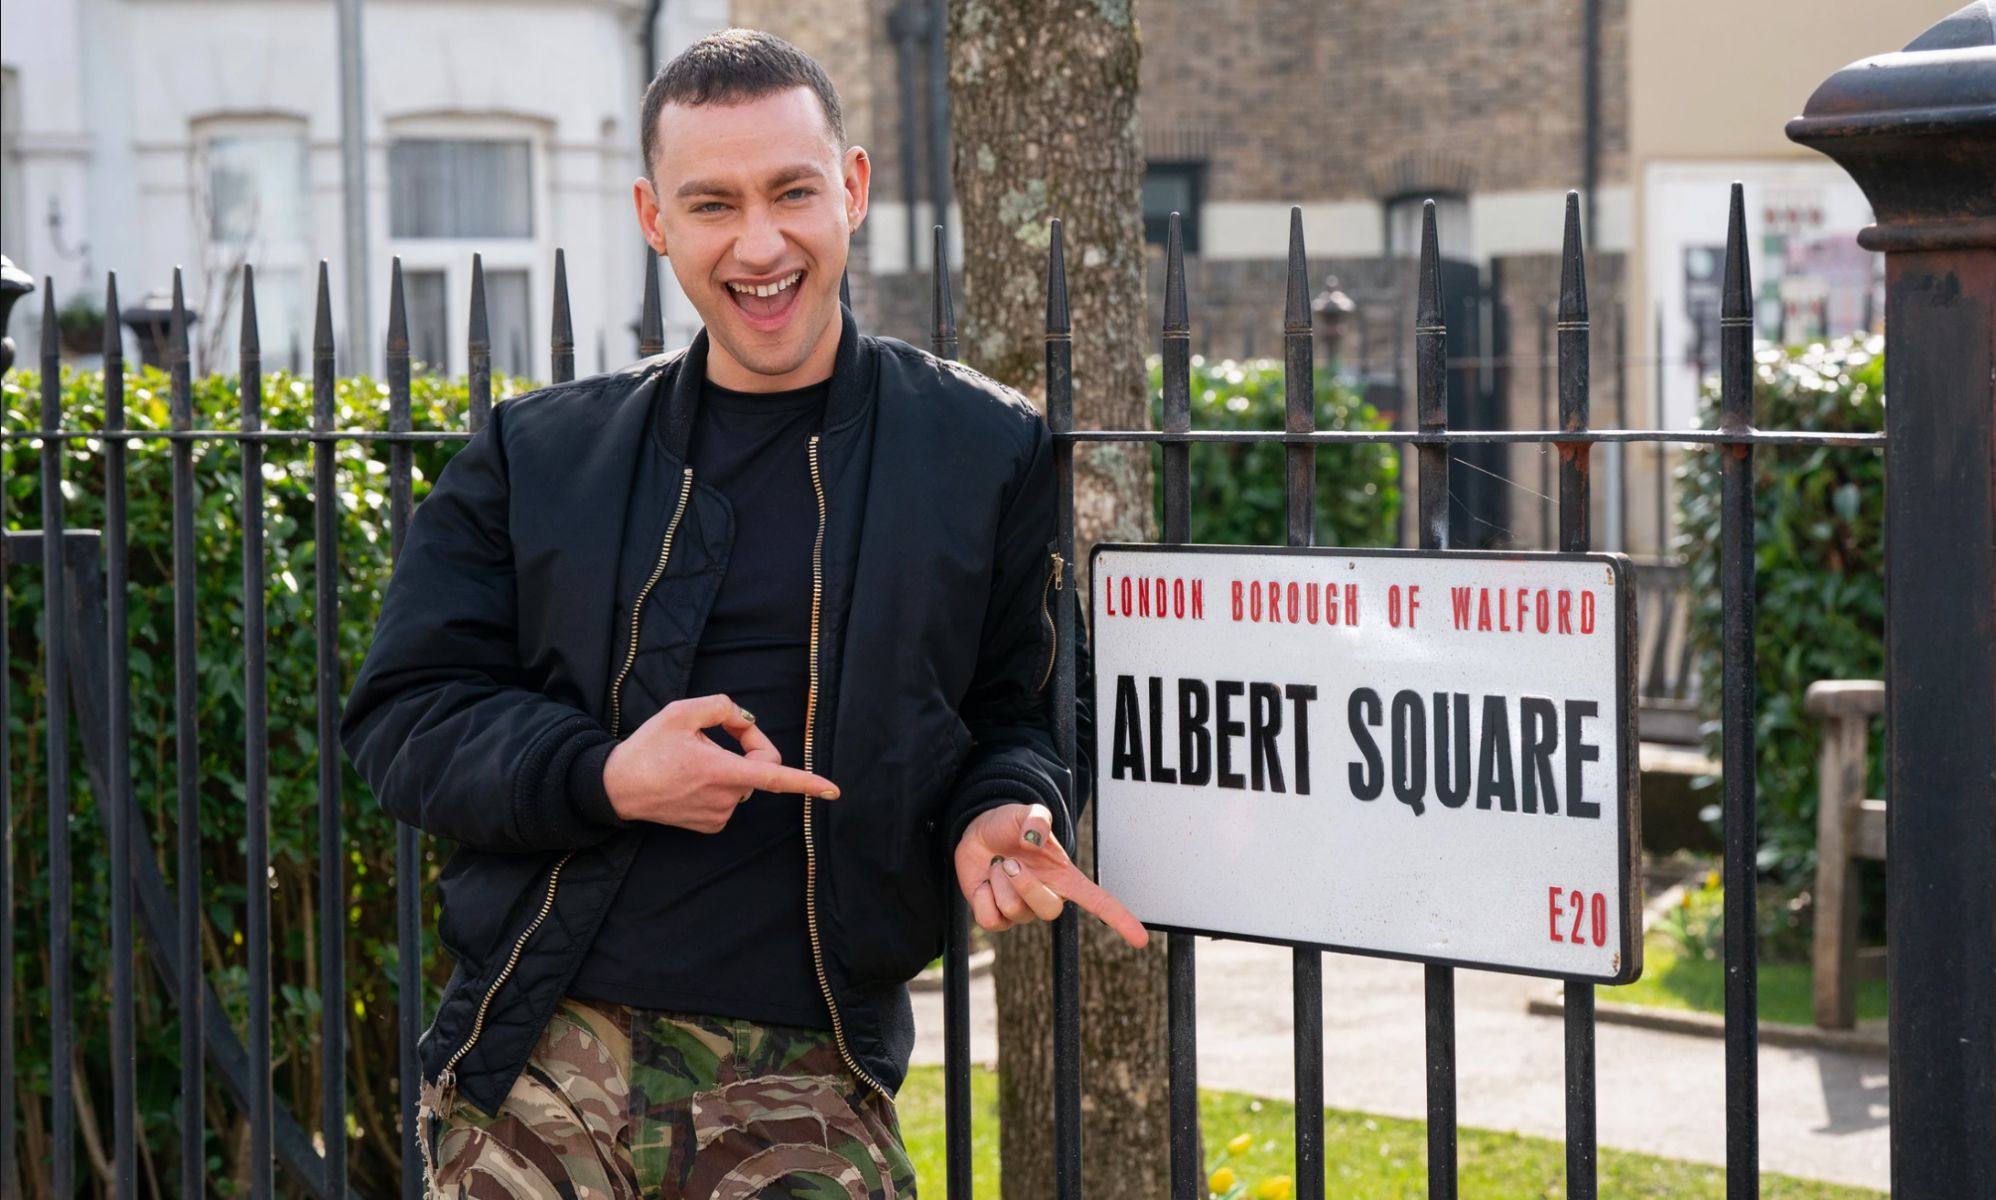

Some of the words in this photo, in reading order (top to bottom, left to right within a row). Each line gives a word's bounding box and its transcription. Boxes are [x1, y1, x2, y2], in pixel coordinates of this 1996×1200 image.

[1106, 576, 1204, 619] LONDON
[1231, 580, 1359, 627] BOROUGH
[1388, 585, 1420, 629] OF
[1451, 586, 1596, 635] WALFORD
[1112, 674, 1317, 796] ALBERT
[1347, 687, 1601, 819] SQUARE
[1548, 886, 1608, 948] E20
